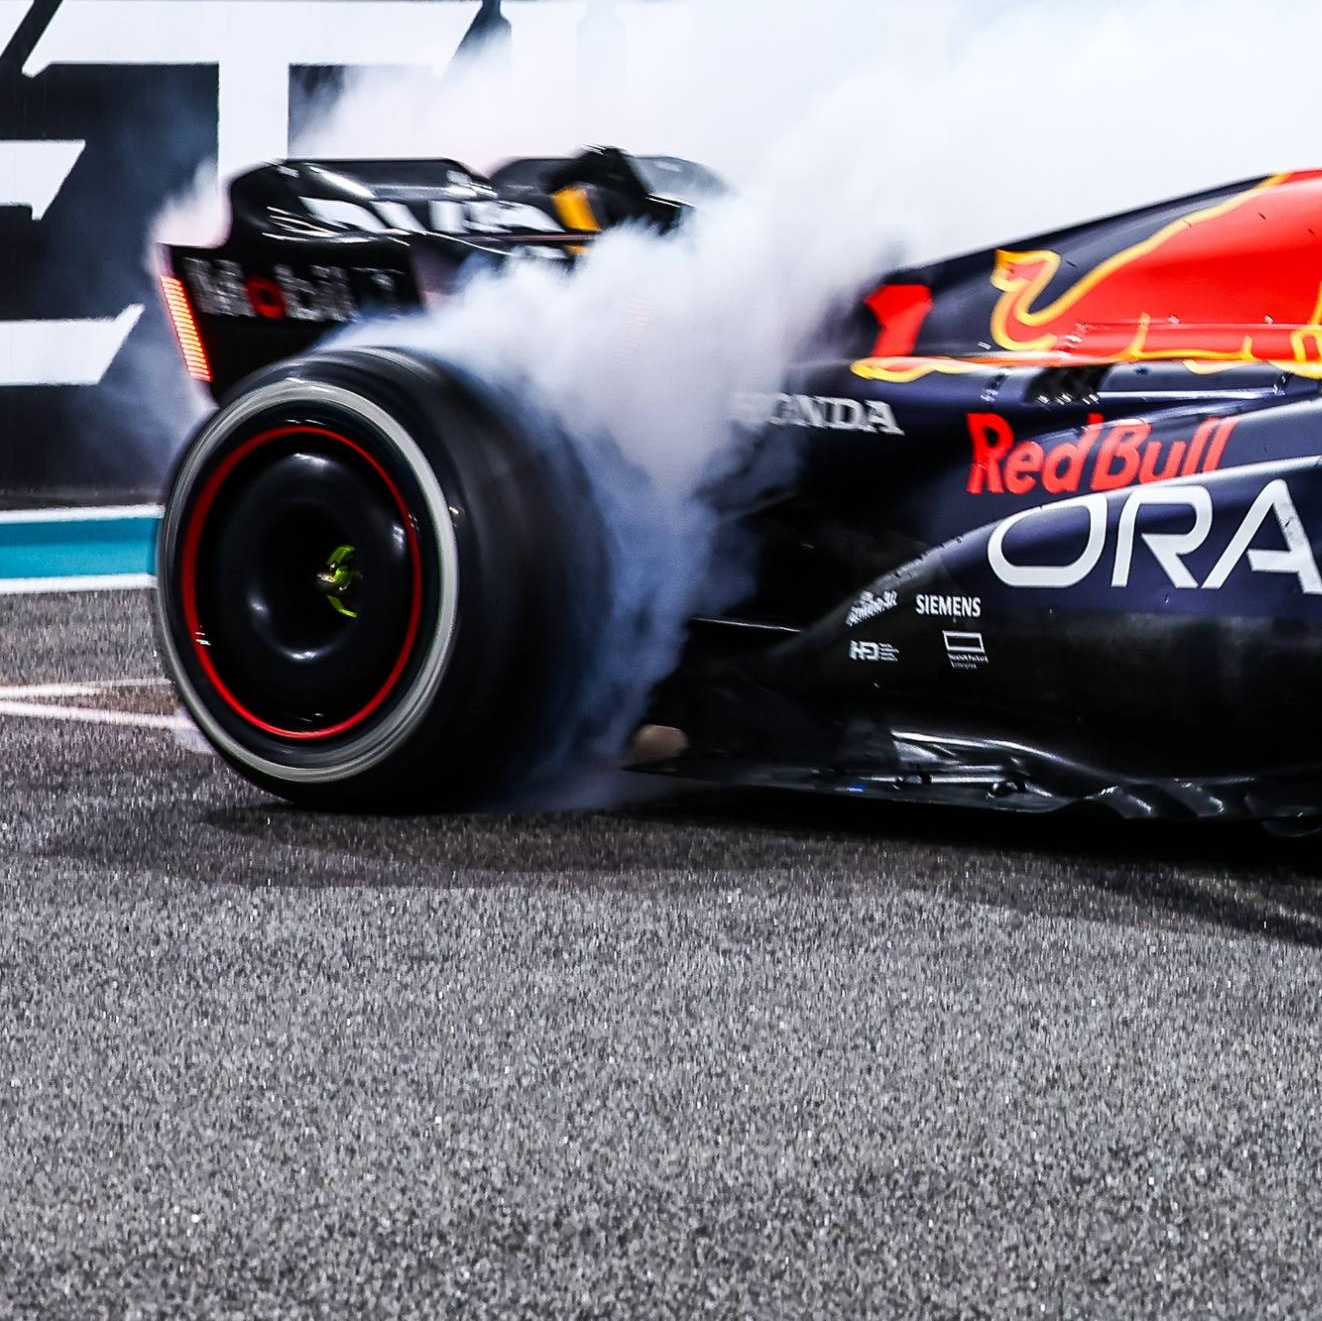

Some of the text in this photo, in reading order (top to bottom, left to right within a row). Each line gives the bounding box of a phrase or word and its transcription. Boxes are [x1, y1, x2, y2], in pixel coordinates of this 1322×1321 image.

[966, 412, 1240, 494] Red Bull
[915, 594, 982, 618] SIEMENS
